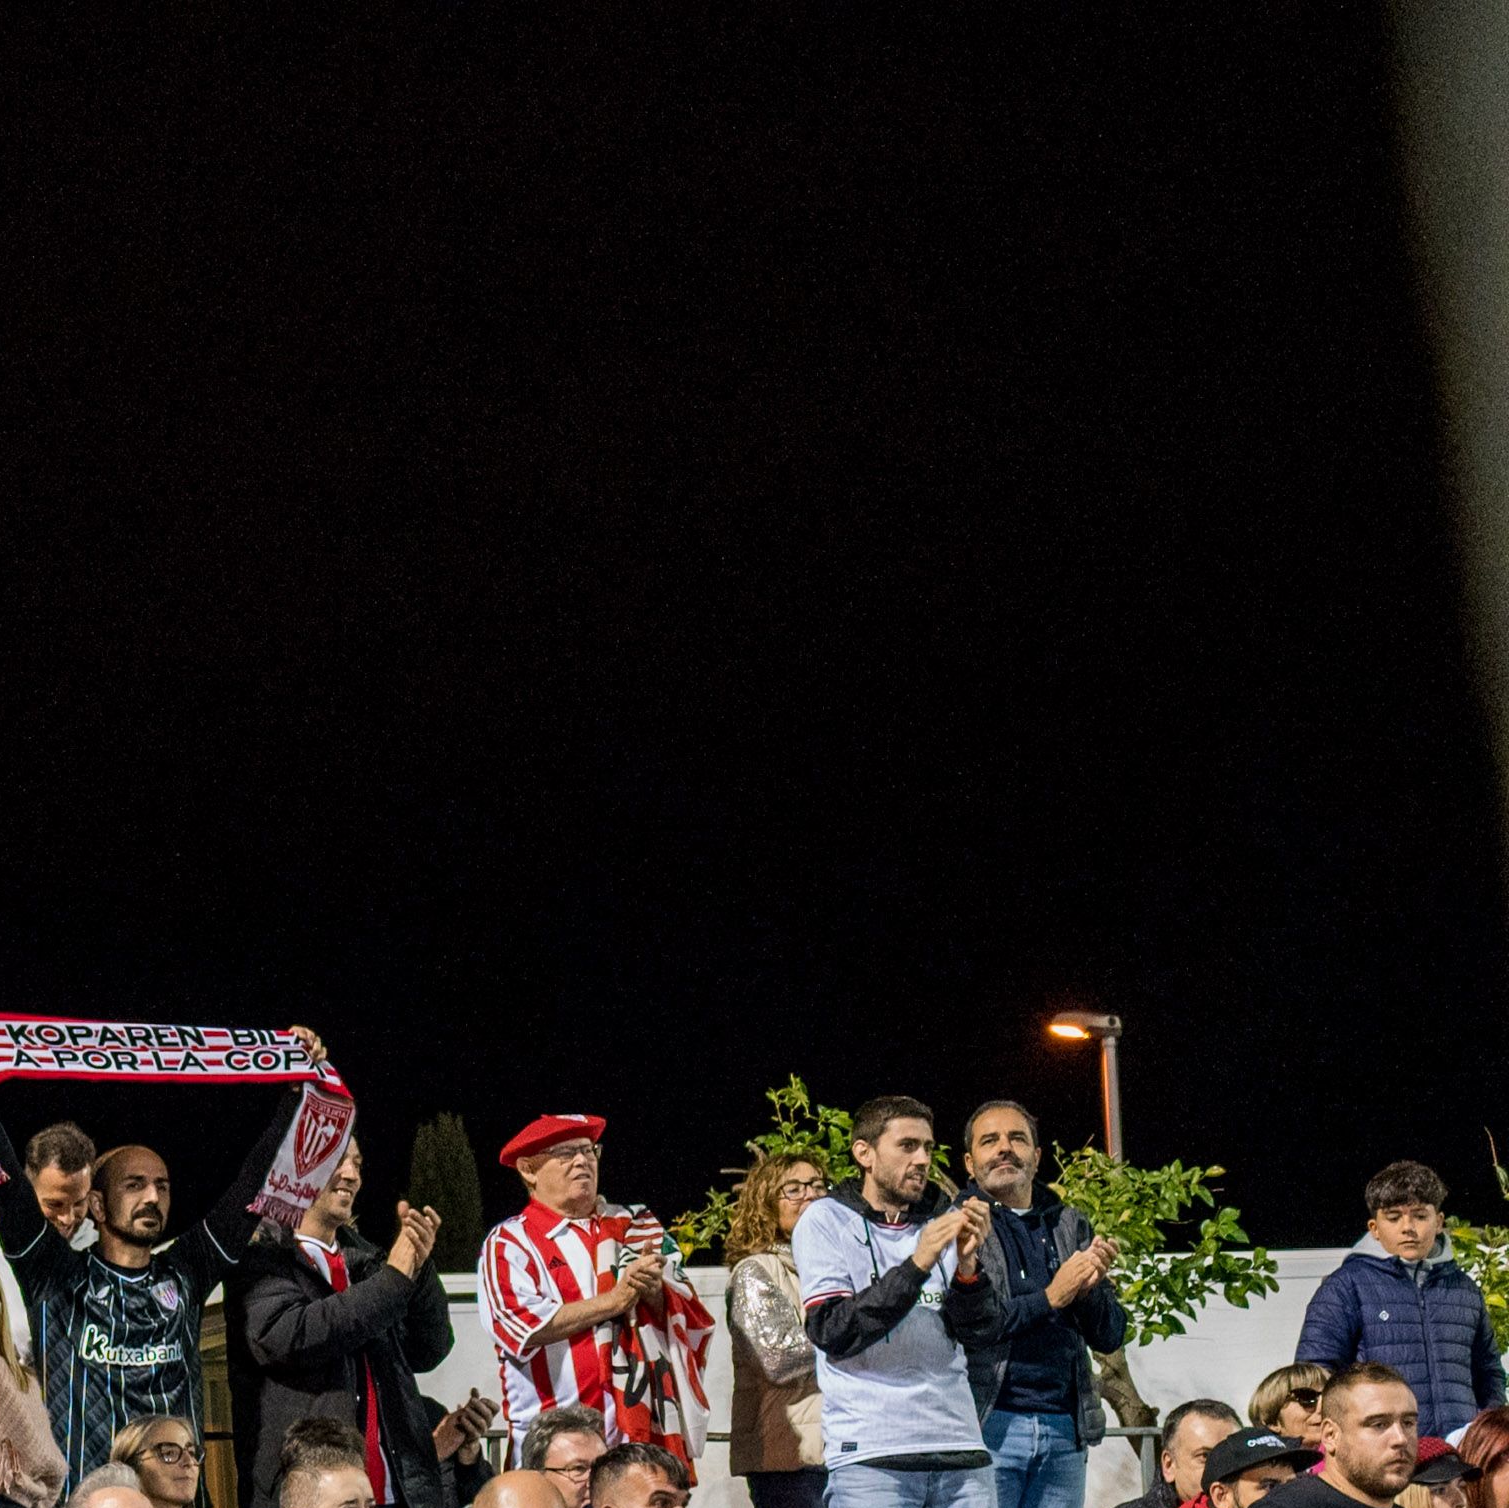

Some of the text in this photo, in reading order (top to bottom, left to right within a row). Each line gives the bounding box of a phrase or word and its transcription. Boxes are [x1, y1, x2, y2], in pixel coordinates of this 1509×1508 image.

[5, 1023, 205, 1047] KOPAREN
[13, 1050, 30, 1067] A
[56, 1050, 146, 1070] POR
[156, 1051, 205, 1071] LA
